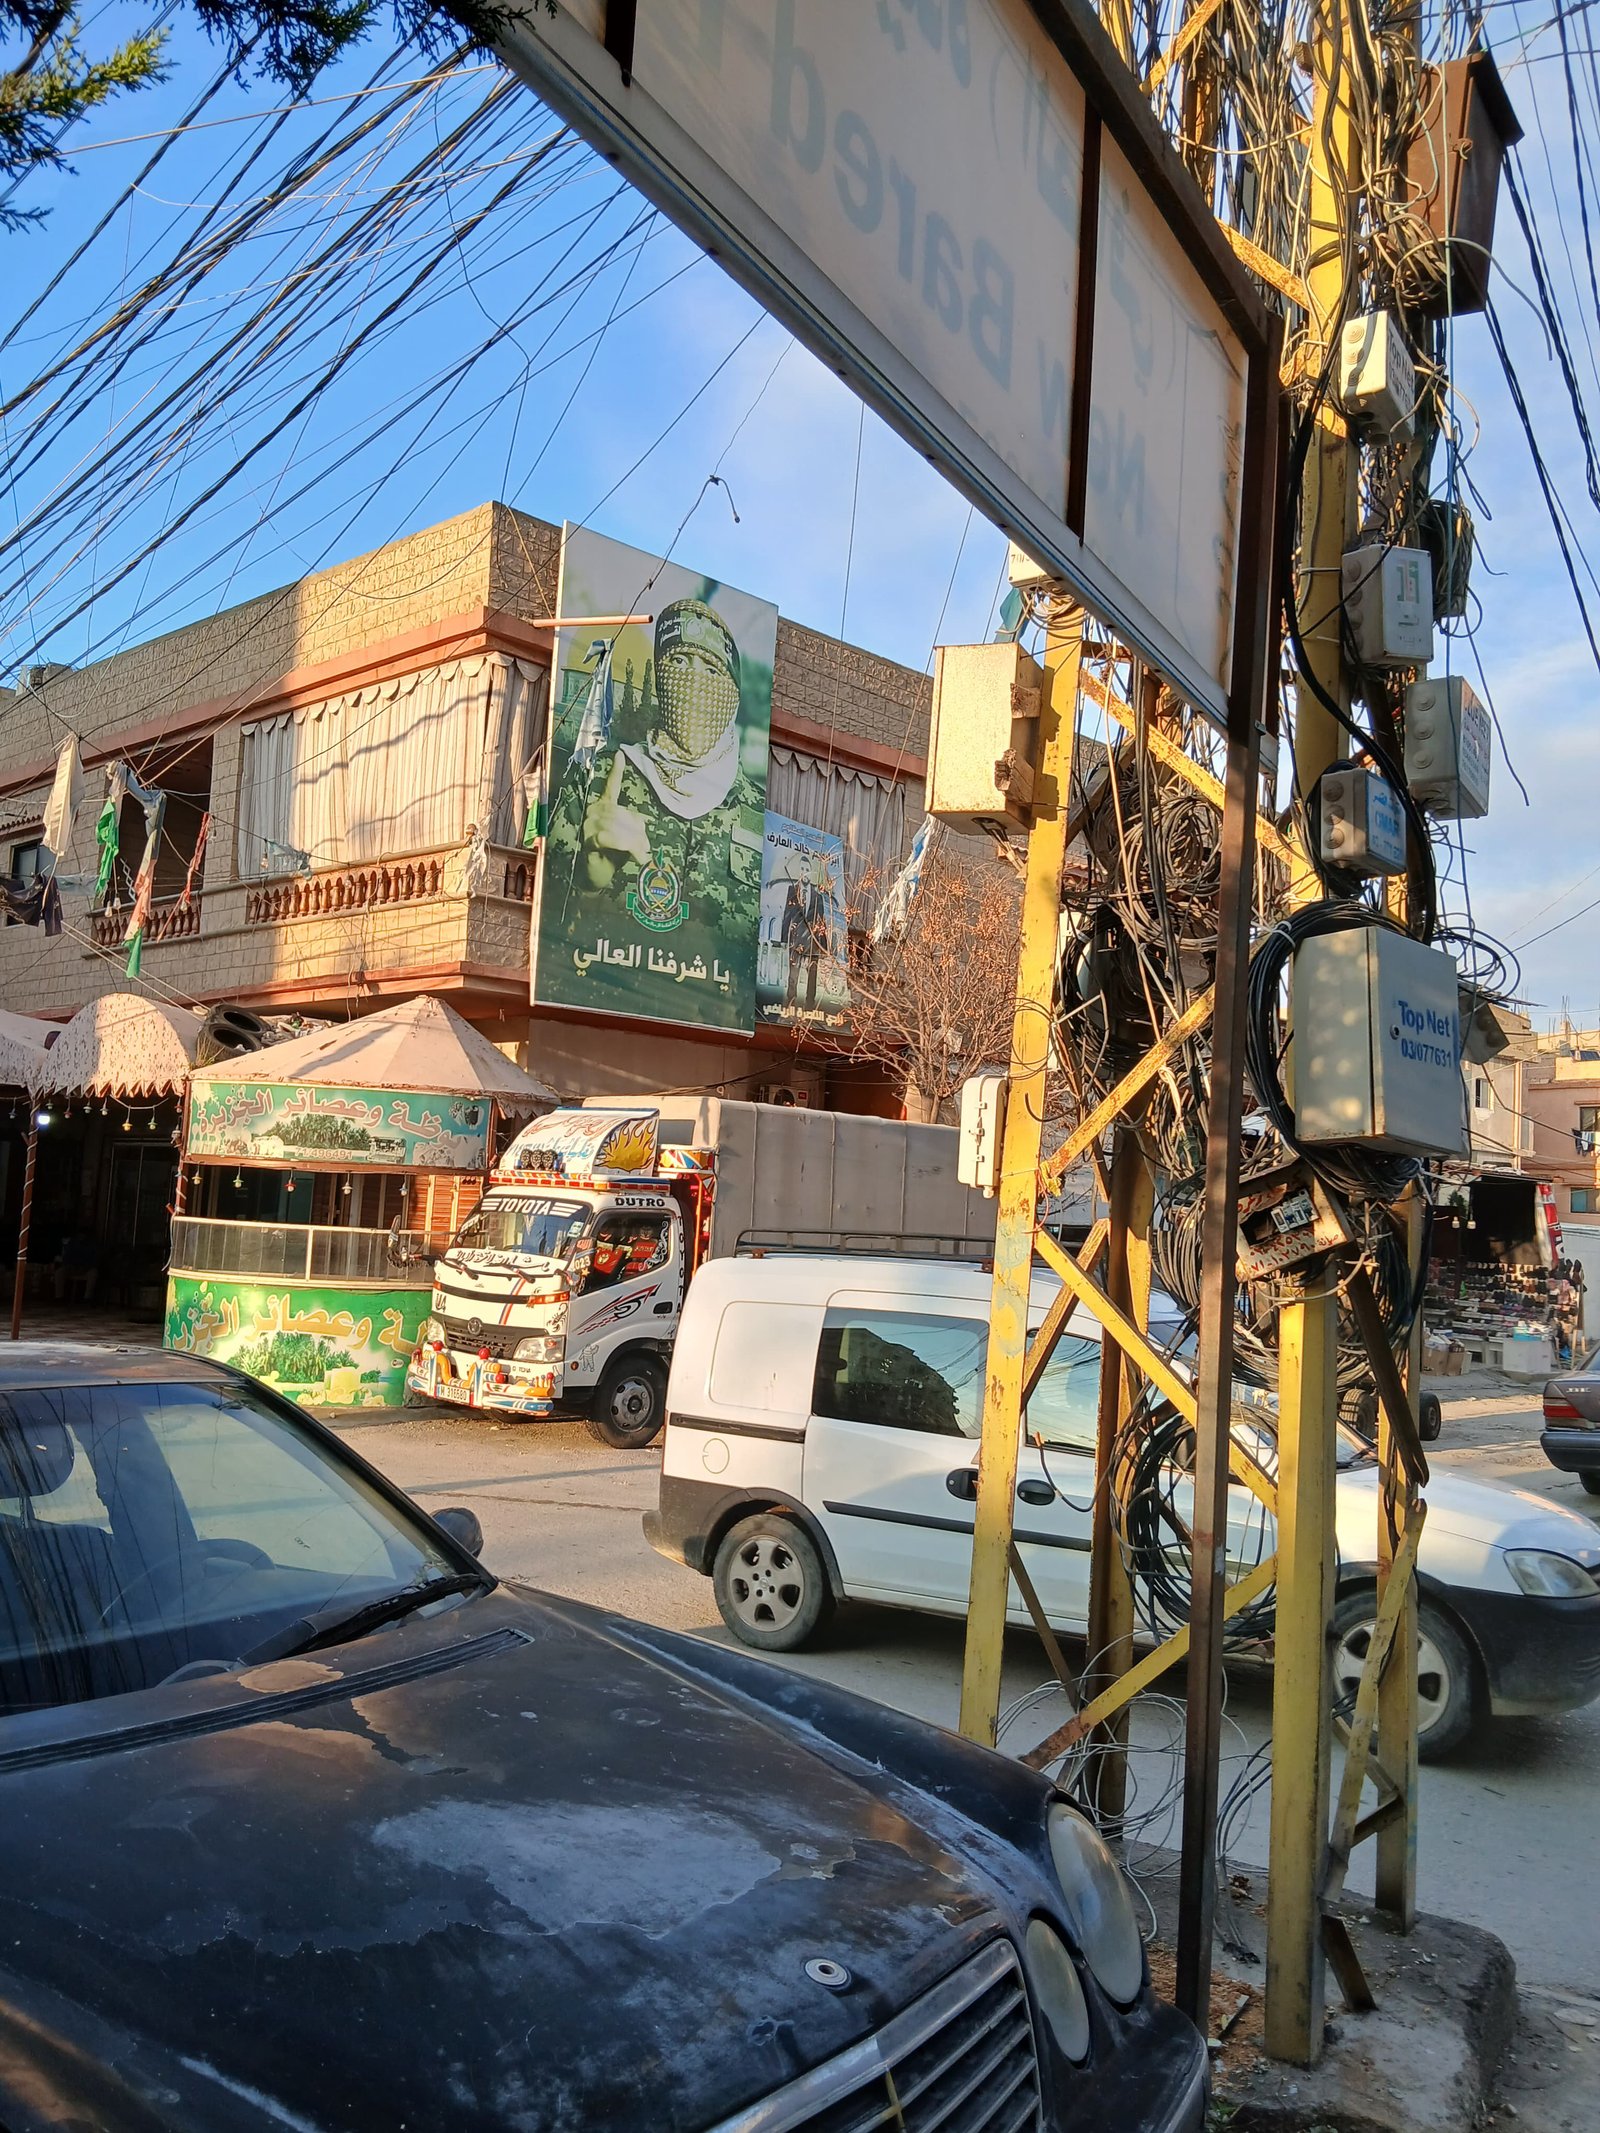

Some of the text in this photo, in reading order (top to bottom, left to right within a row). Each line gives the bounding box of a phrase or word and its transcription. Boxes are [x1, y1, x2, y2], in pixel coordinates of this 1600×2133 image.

[573, 938, 730, 992] يا شرفنا العالي
[1398, 1000, 1450, 1038] Top Net
[198, 1086, 274, 1135] الجزيرة
[276, 1087, 383, 1128] وعصائر
[497, 1197, 552, 1216] TOYOTA
[614, 1197, 665, 1207] DUTRO
[245, 1293, 373, 1349] وعصائر
